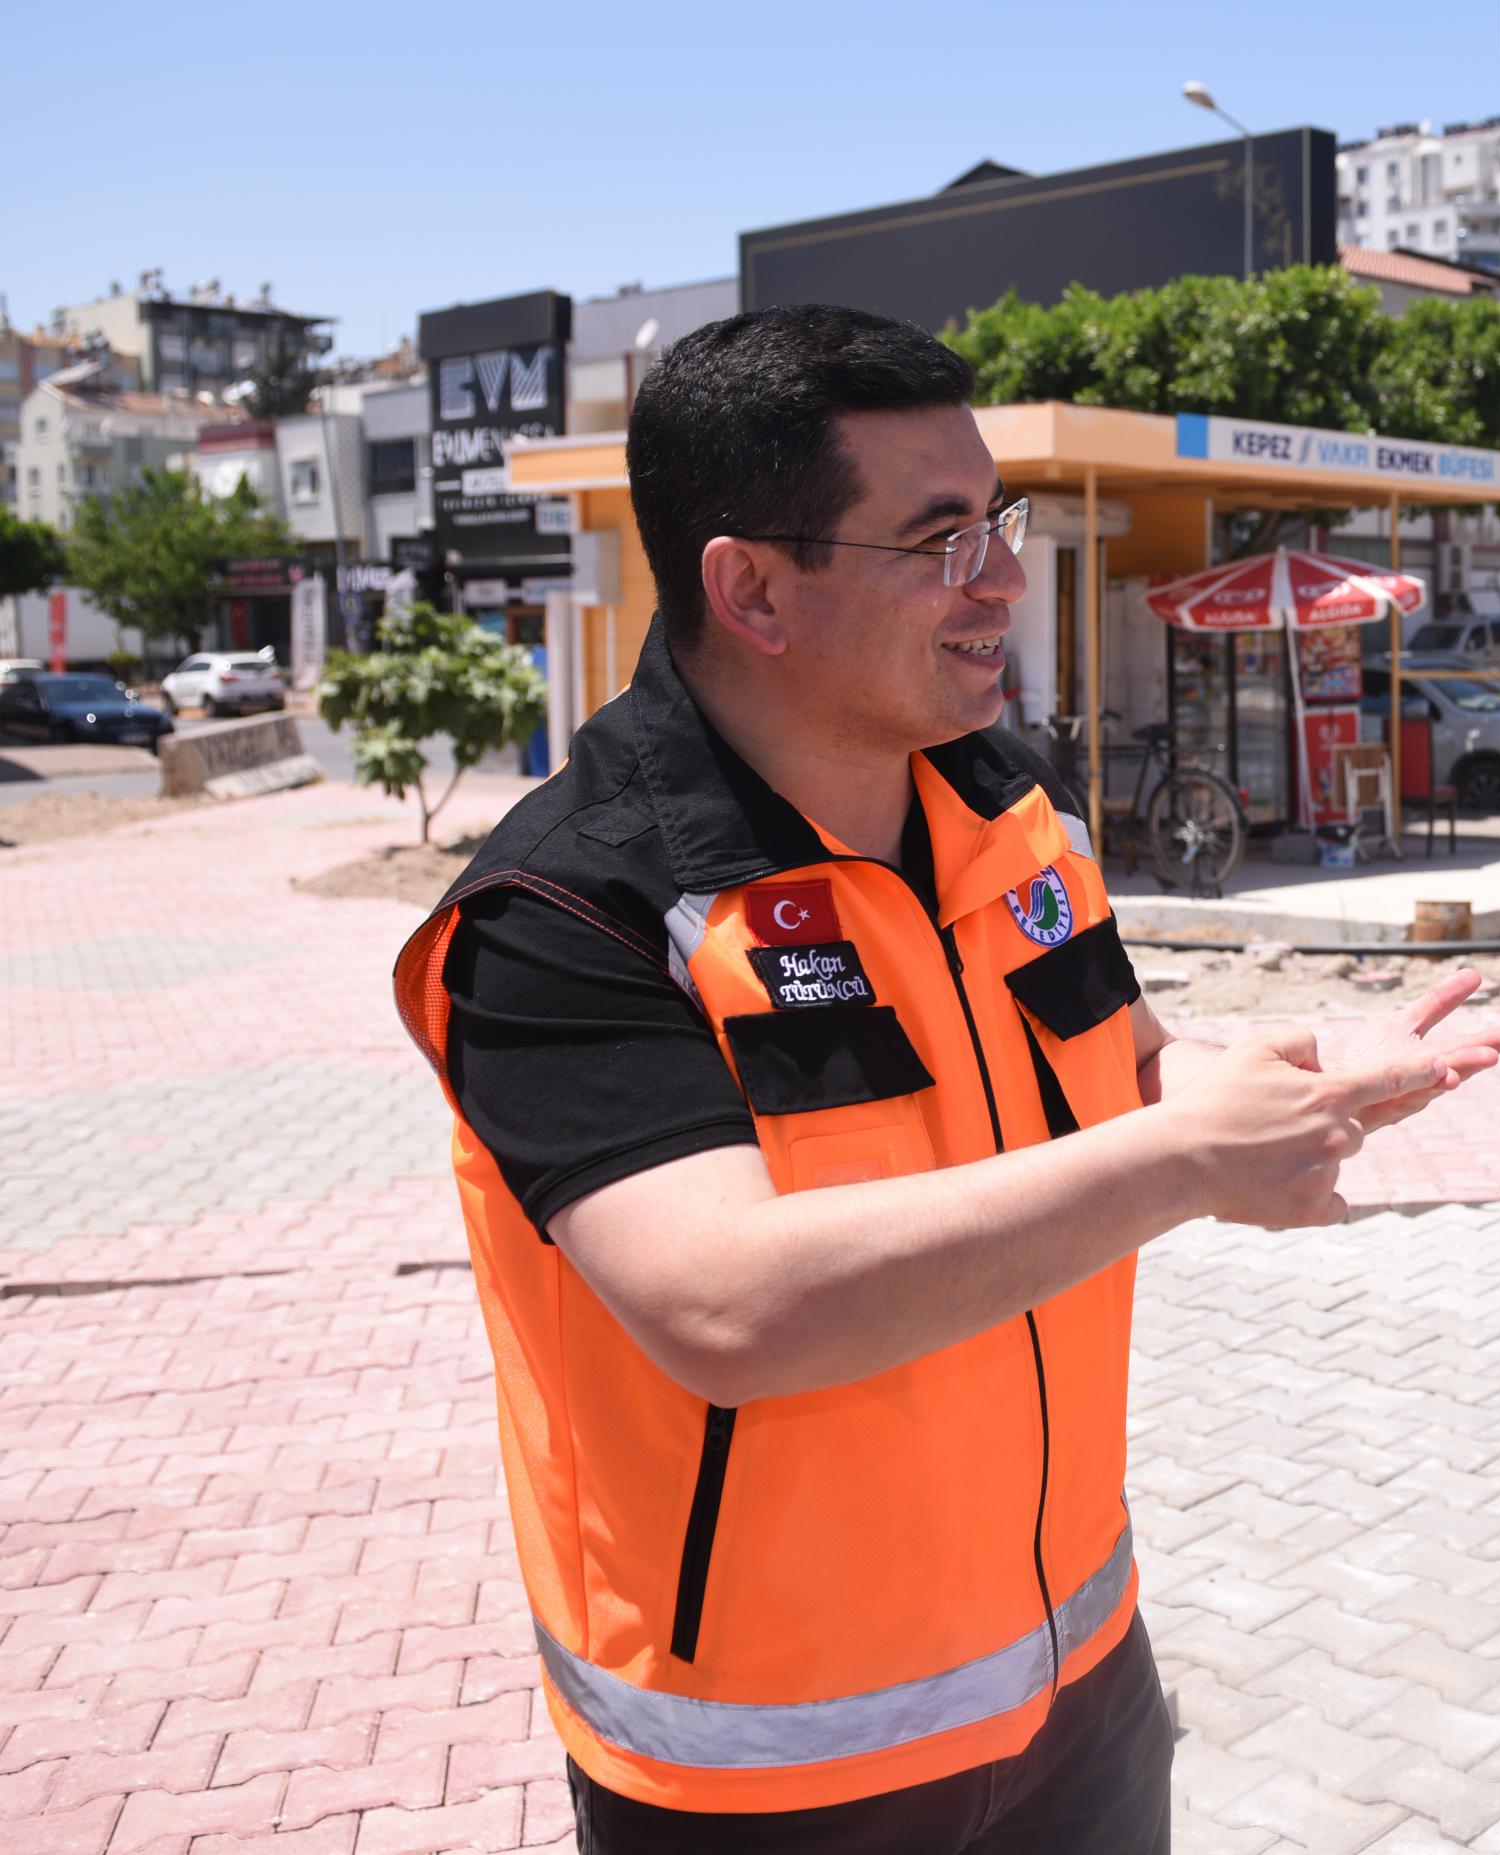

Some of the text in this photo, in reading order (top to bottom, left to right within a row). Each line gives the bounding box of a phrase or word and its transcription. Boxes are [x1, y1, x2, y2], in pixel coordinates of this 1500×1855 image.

[440, 347, 554, 421] EVM
[1232, 430, 1291, 460] KEPEZ
[1376, 447, 1434, 475] EKMEK
[779, 949, 846, 980] Hakan
[779, 976, 869, 1003] TÜTÜNCÜ
